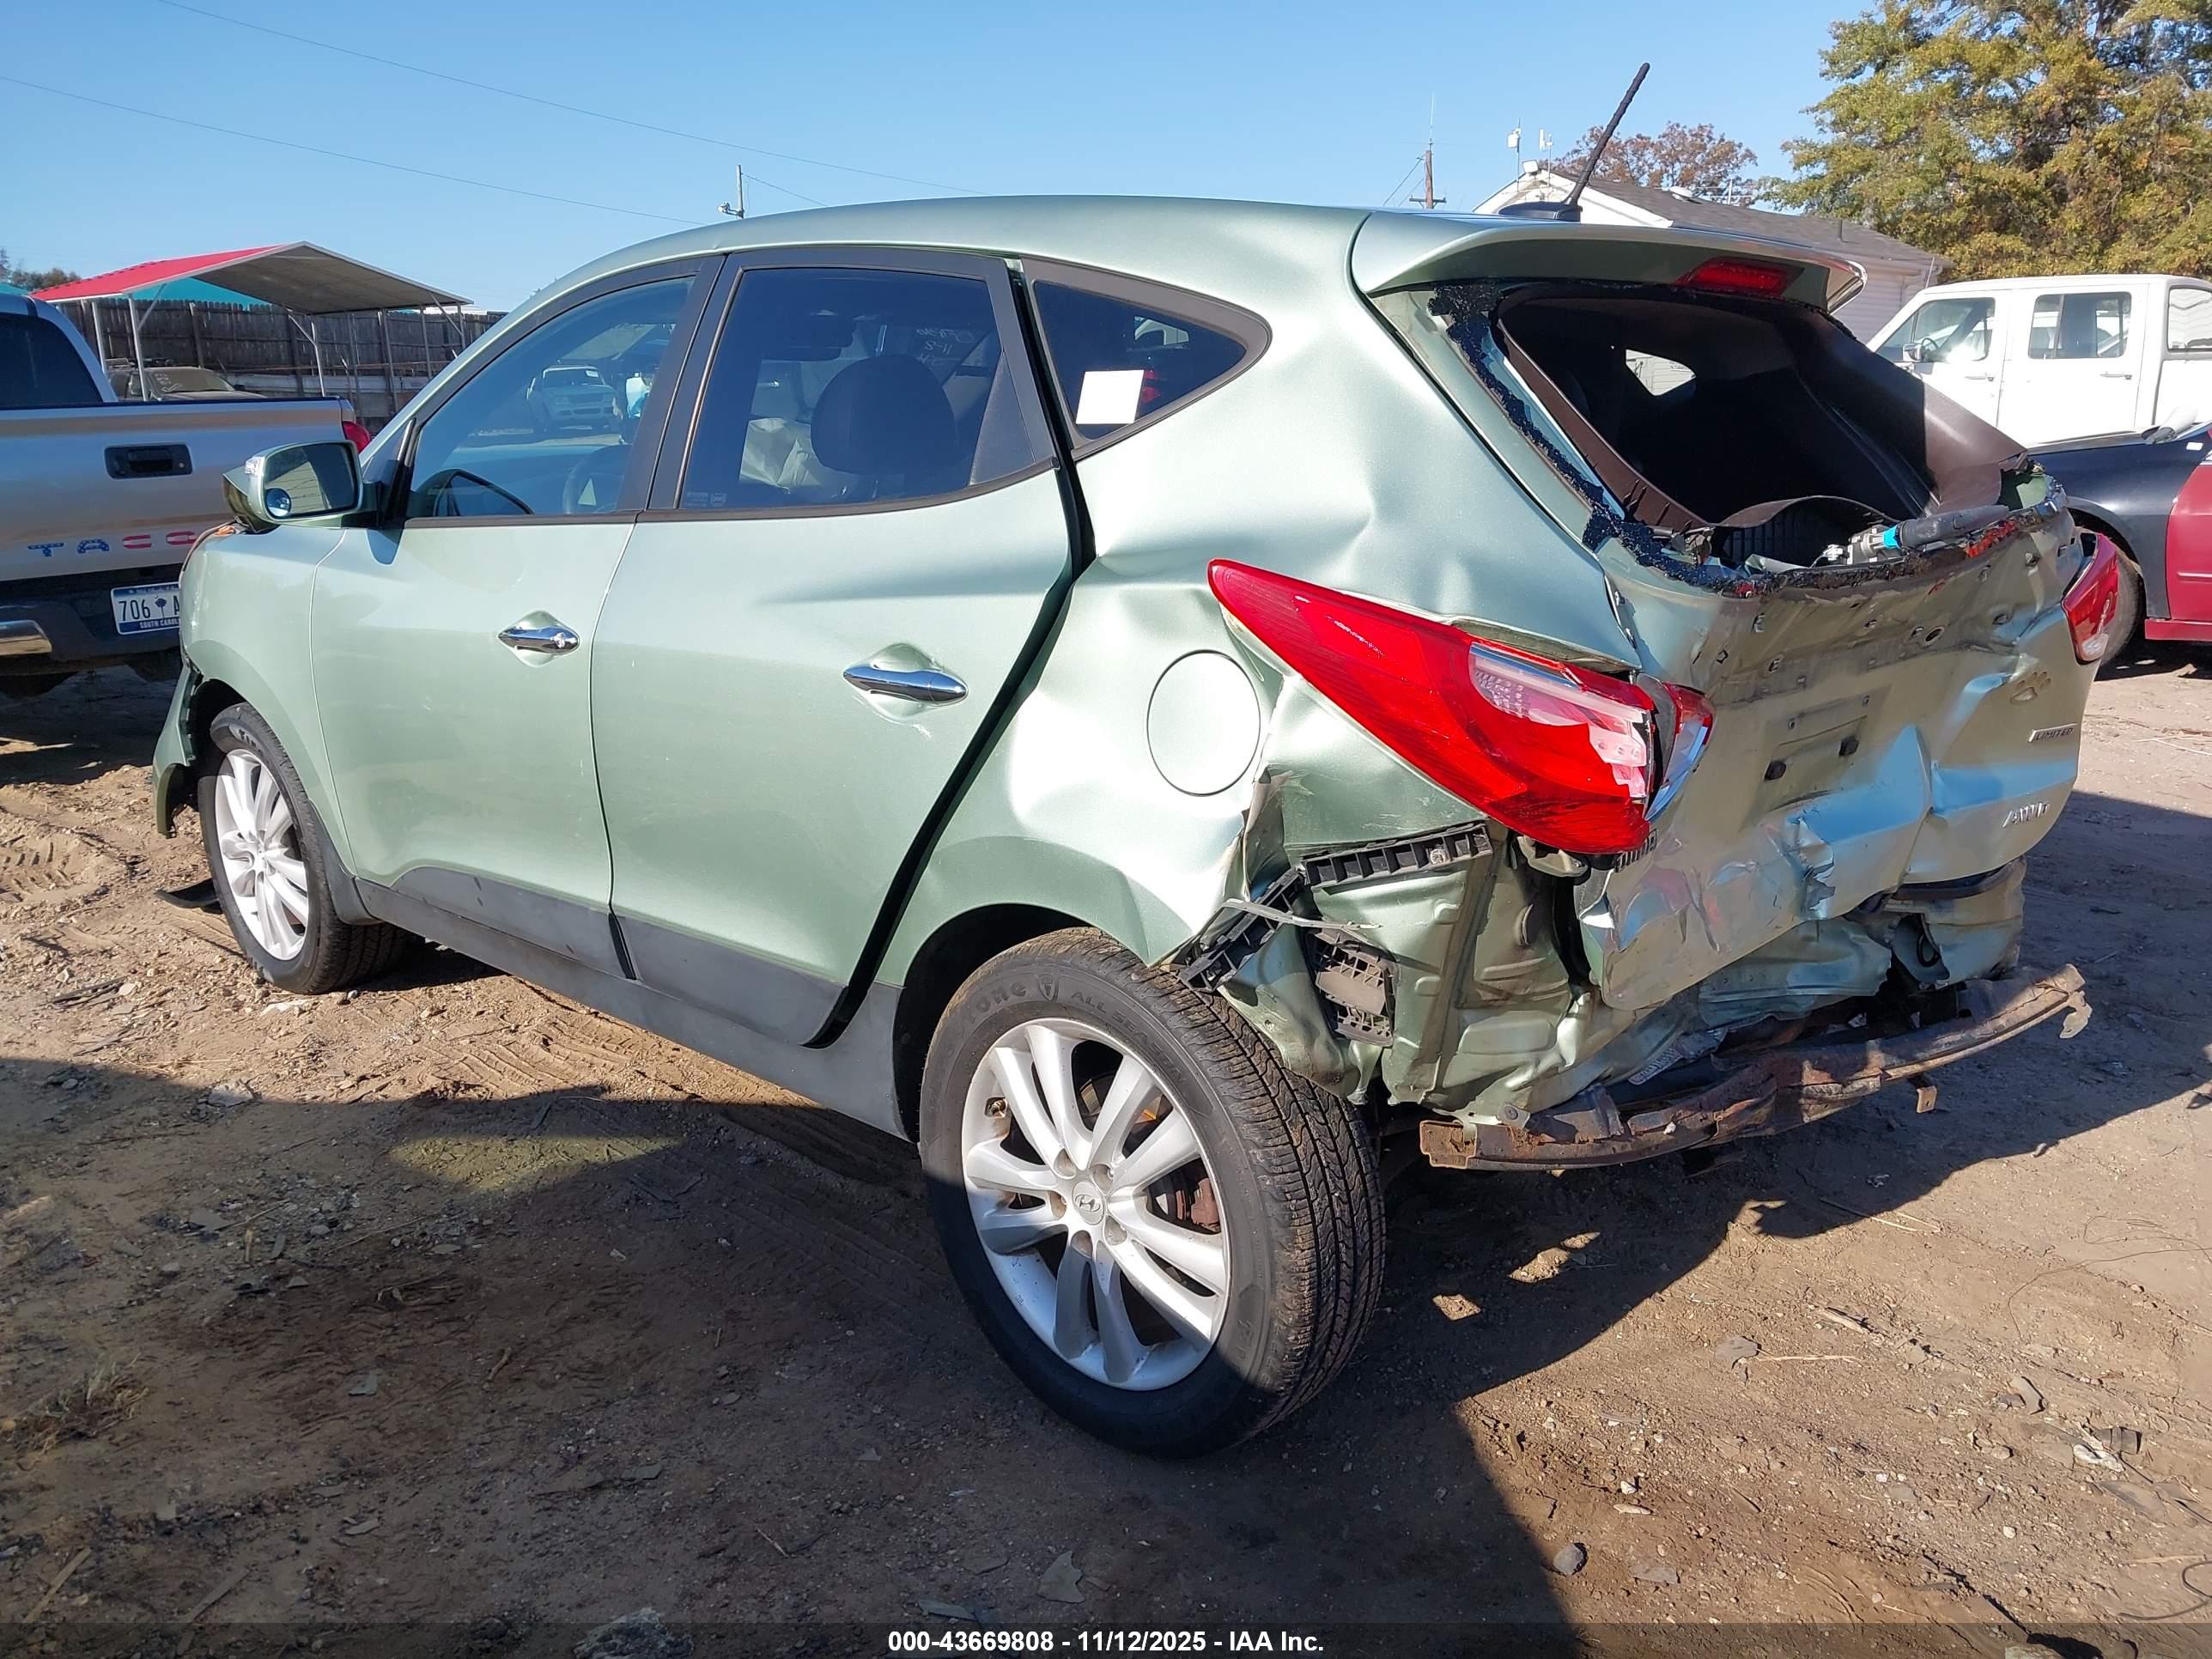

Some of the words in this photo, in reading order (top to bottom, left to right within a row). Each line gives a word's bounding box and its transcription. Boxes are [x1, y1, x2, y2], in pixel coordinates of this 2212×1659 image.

[118, 599, 151, 621] 706
[2035, 727, 2075, 741] LIMITED
[1071, 991, 1107, 1014] ALL
[1111, 1011, 1186, 1083] SEASON
